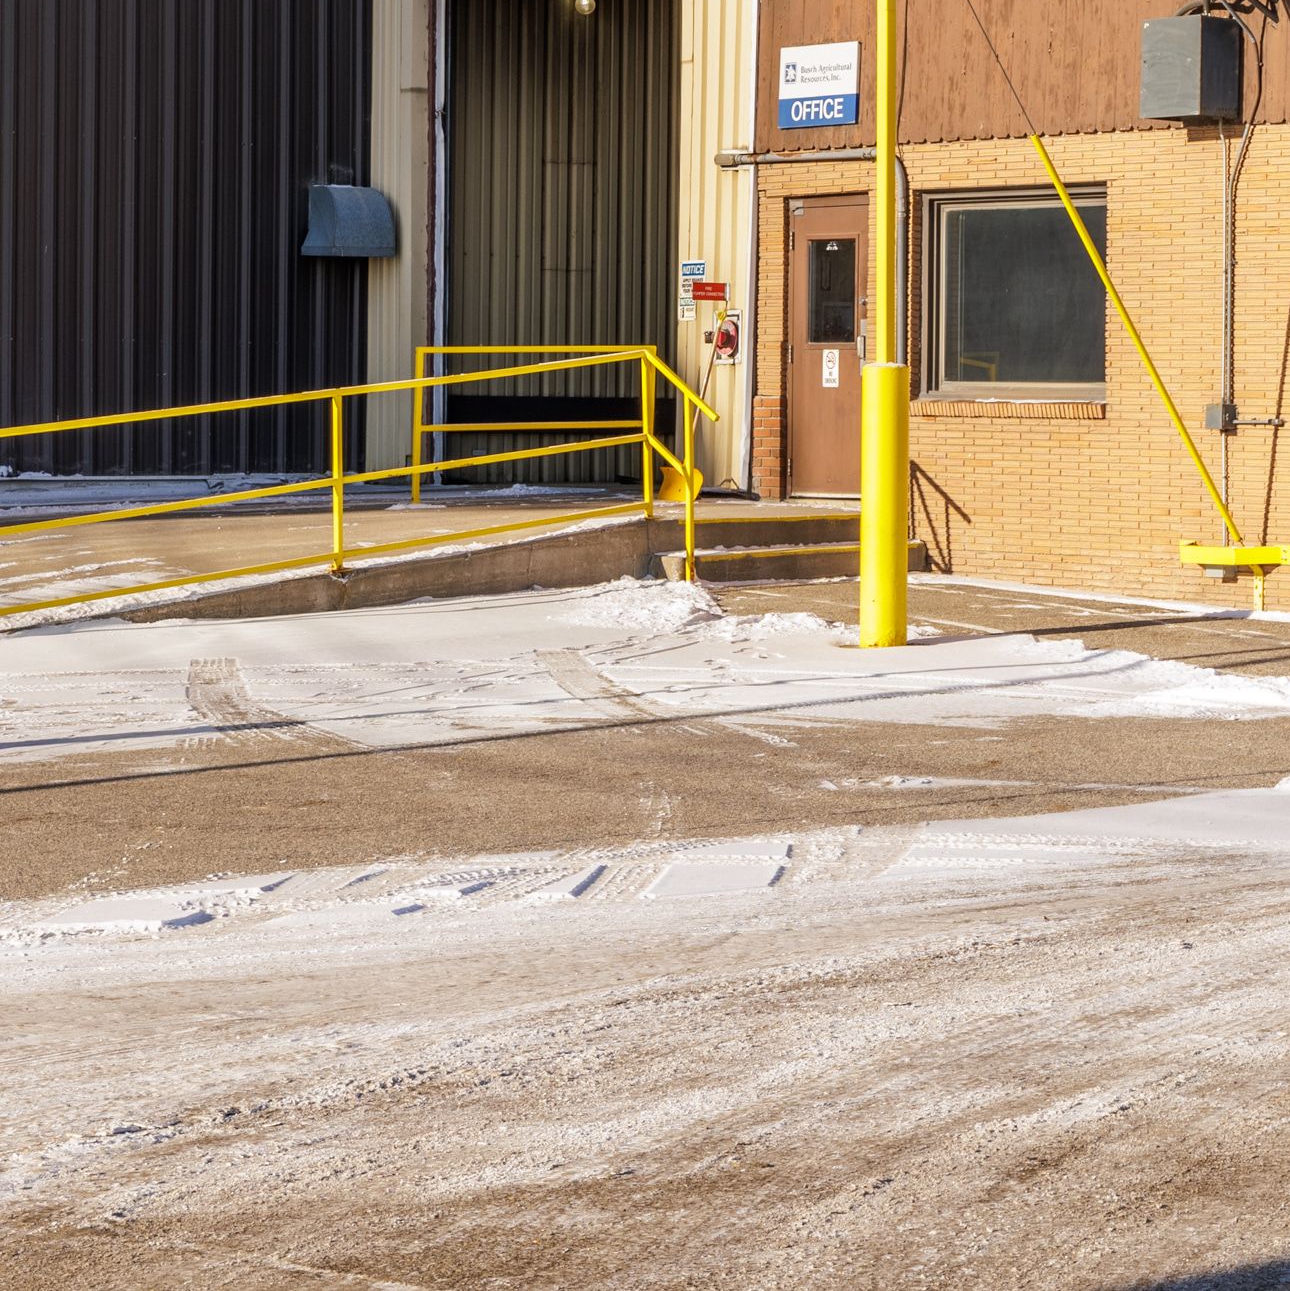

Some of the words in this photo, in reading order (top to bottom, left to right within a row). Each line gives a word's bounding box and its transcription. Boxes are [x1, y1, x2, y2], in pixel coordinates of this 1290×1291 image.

[800, 66, 817, 74] Busch
[818, 63, 852, 73] Agricultural
[791, 97, 844, 122] OFFICE
[682, 265, 705, 275] NOTICE
